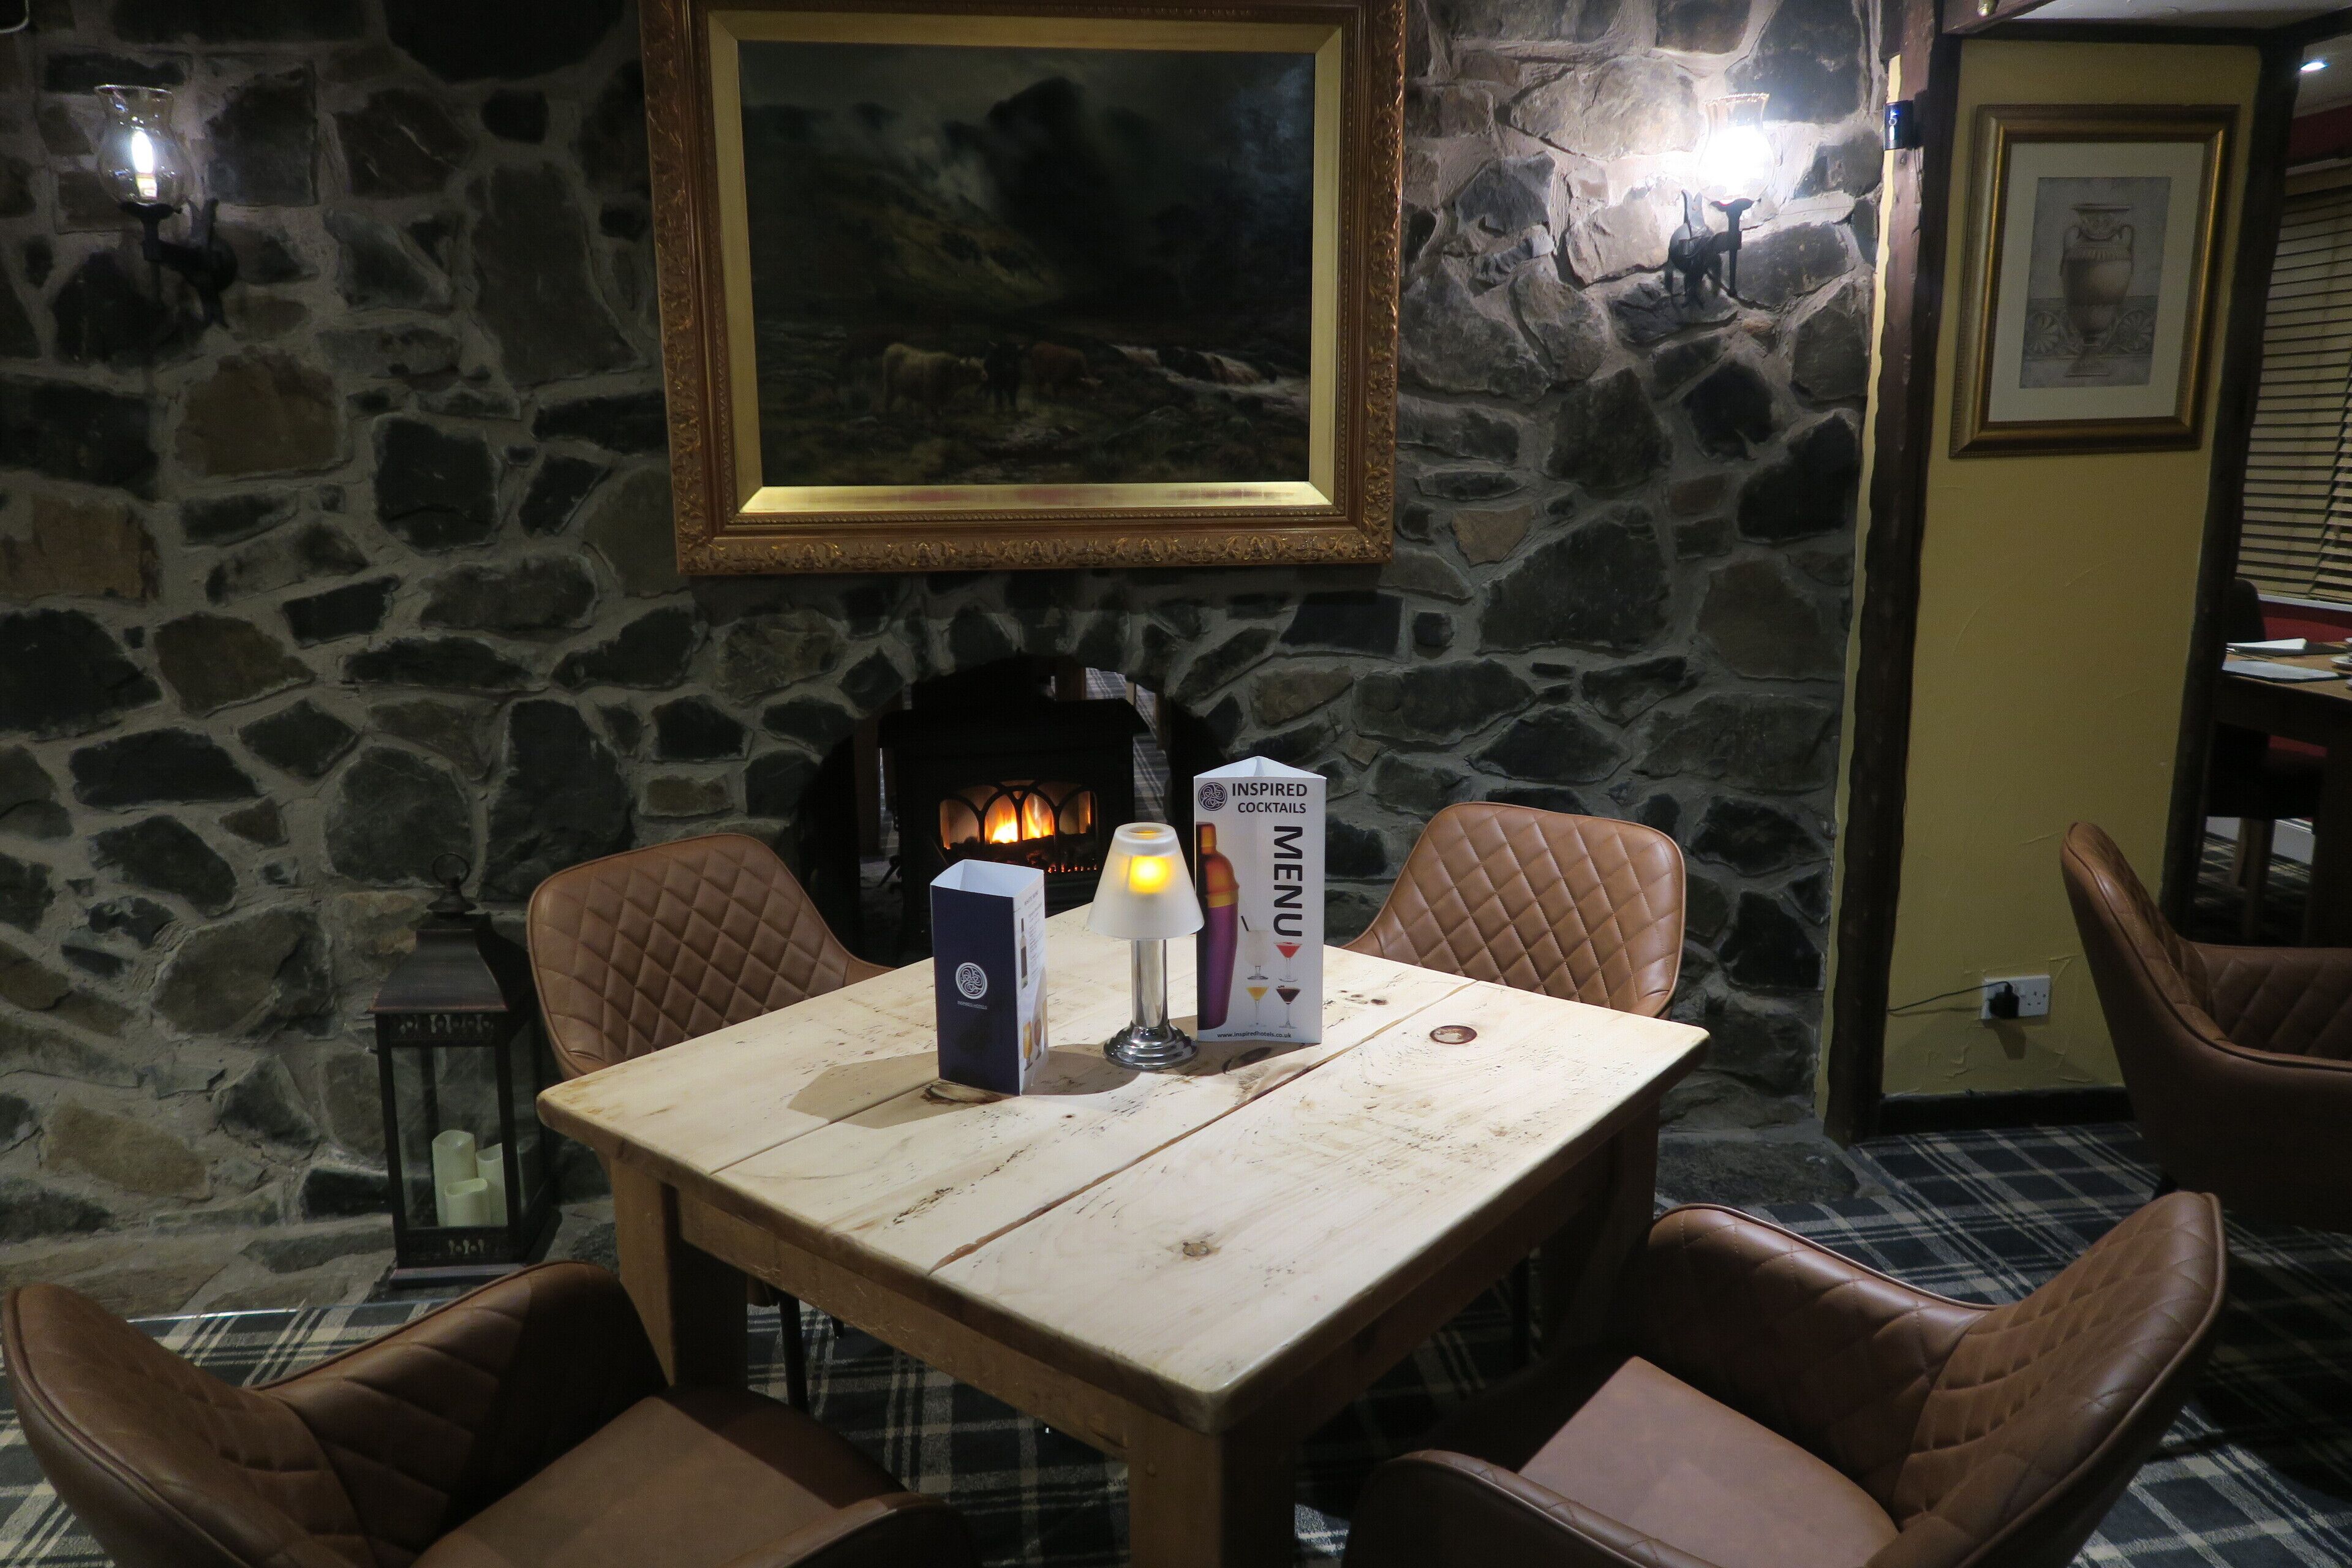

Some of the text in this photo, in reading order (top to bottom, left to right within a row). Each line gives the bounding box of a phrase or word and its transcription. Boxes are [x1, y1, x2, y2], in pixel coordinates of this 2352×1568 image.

[1232, 783, 1307, 796] INSPIRED
[1238, 802, 1306, 813] COCKTAILS
[1273, 826, 1303, 937] MENU
